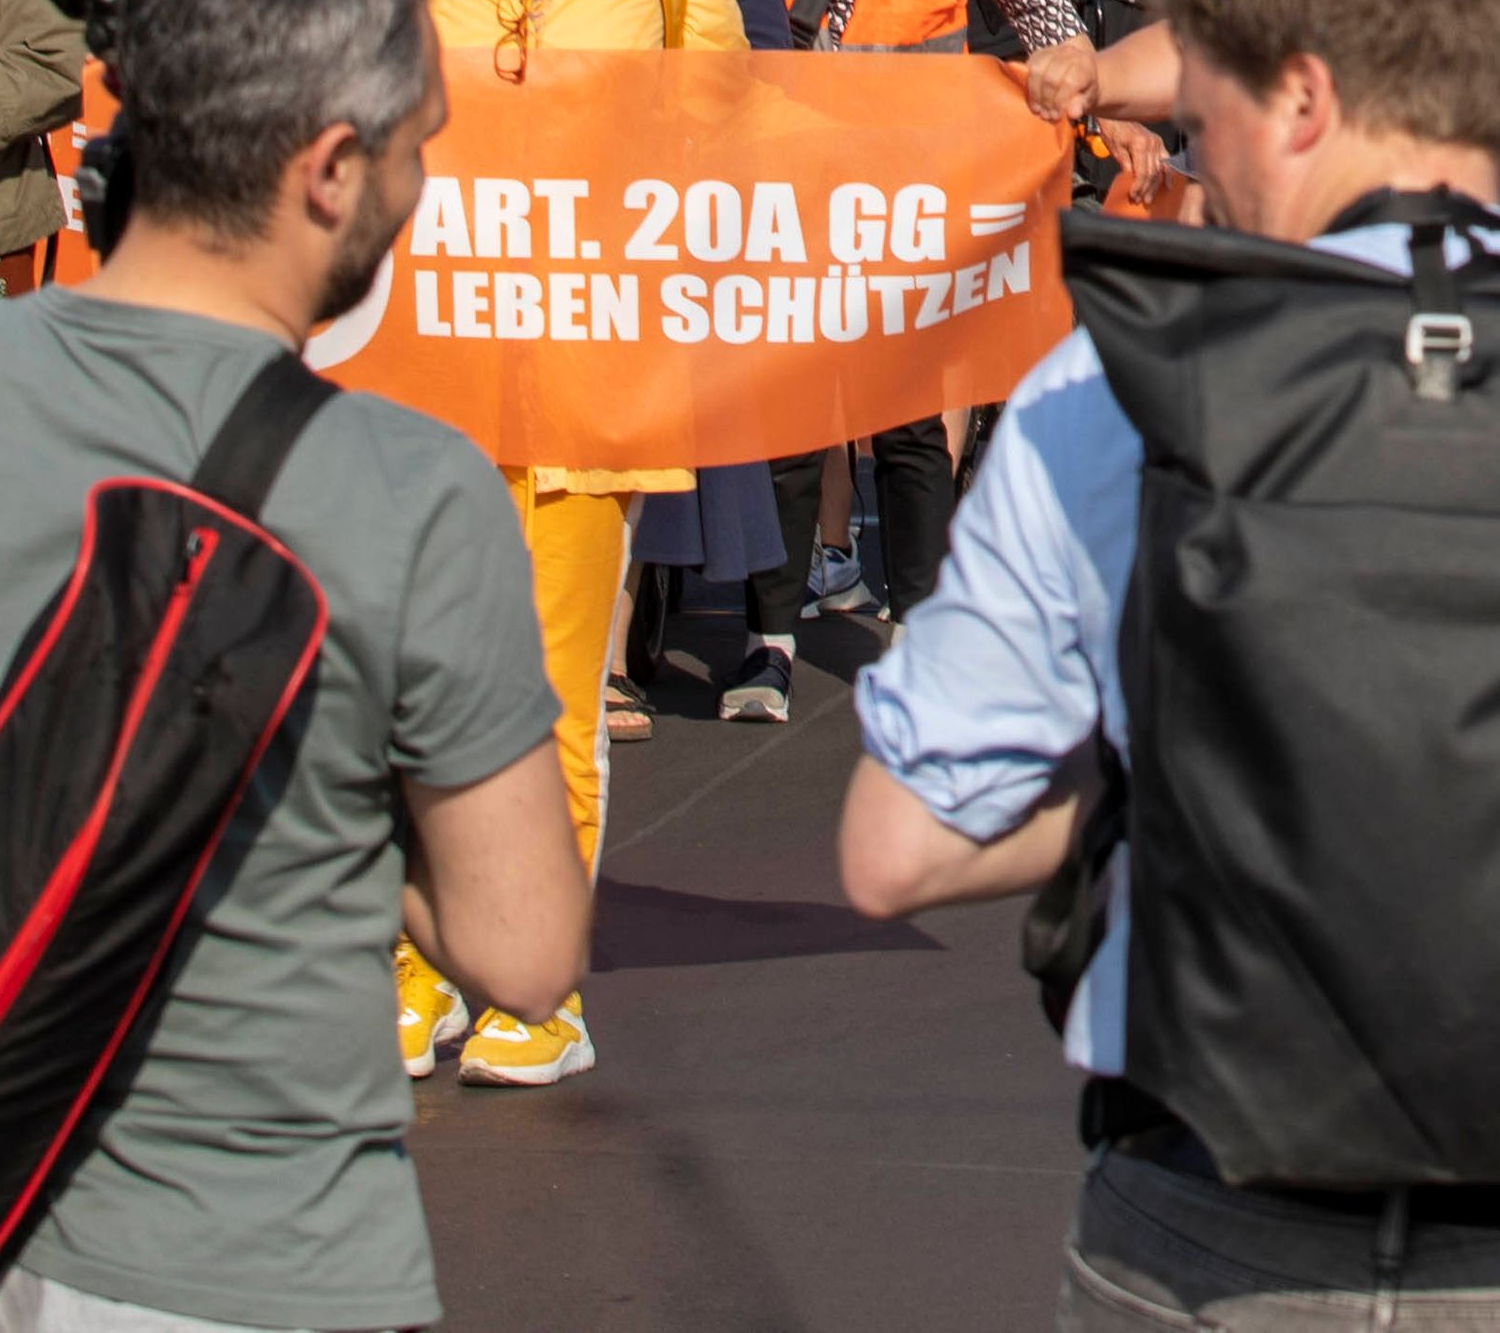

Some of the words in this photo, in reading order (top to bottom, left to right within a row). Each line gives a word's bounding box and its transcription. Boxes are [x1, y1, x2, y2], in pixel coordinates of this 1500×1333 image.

[410, 177, 600, 259] ART.
[624, 179, 808, 263] 20A
[829, 183, 947, 263] GG
[970, 202, 1026, 237] =
[414, 270, 640, 341] LEBEN
[660, 242, 1031, 344] SCHÜTZEN
